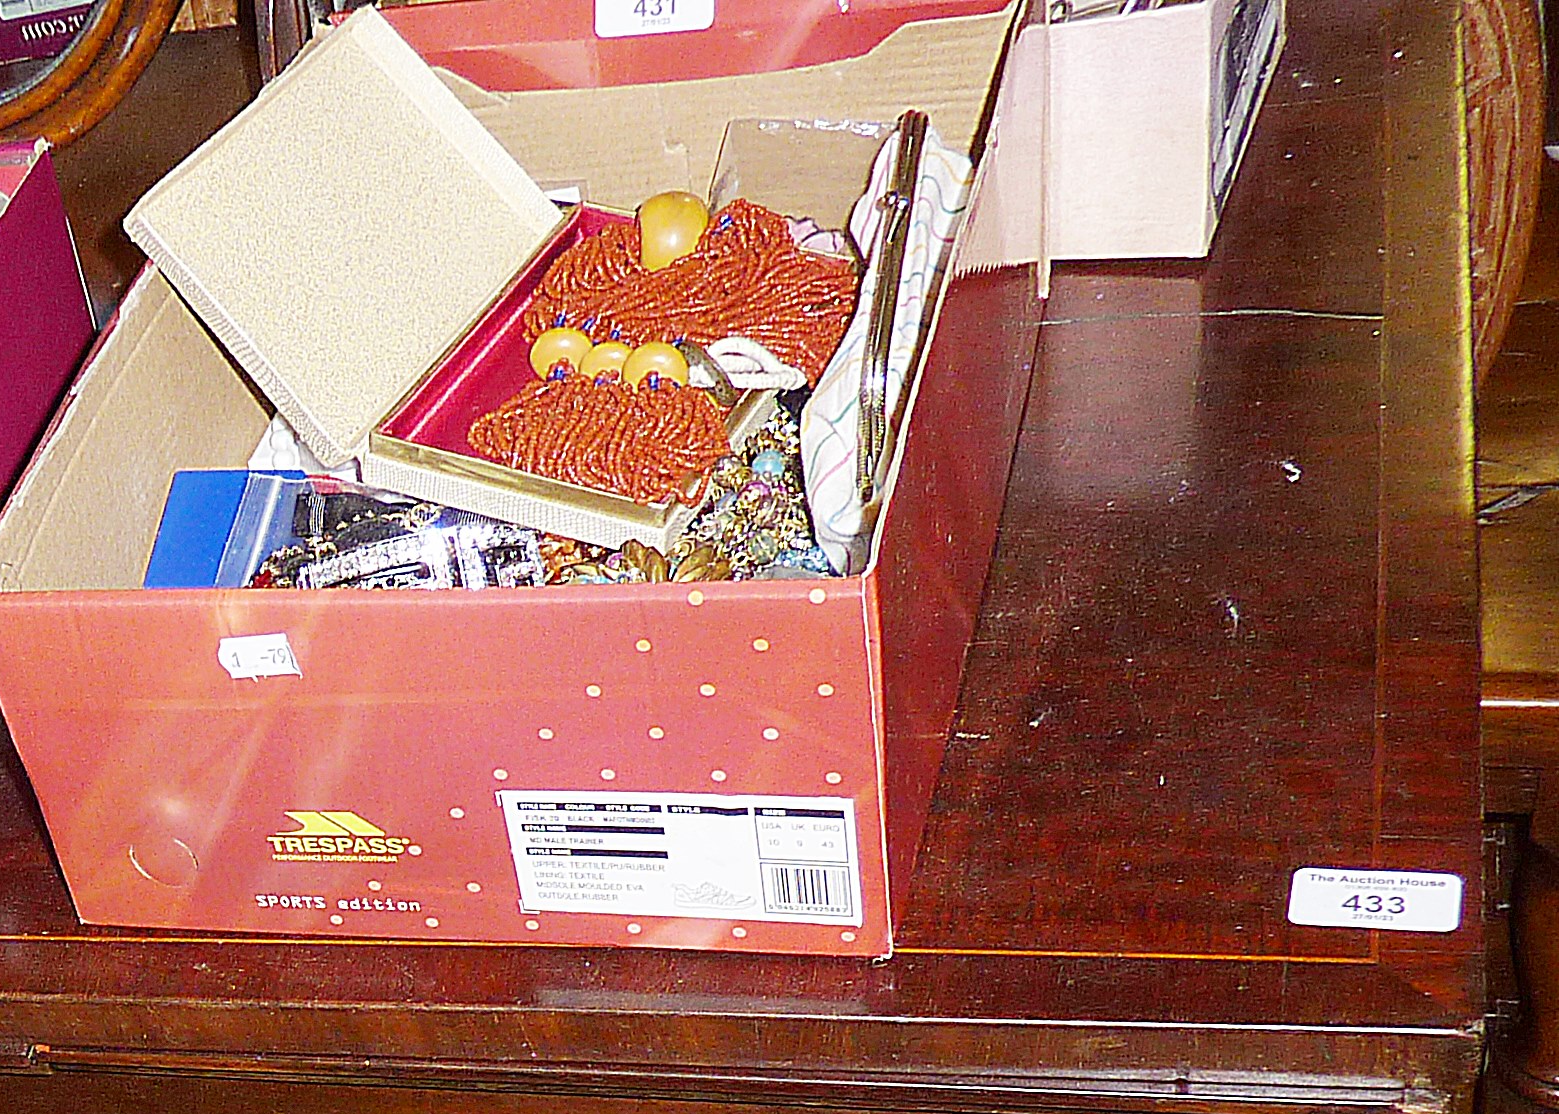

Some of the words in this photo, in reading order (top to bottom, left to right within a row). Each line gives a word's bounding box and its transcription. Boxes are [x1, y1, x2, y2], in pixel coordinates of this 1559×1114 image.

[761, 822, 782, 830] USA
[792, 823, 806, 831] UK
[813, 824, 840, 832] EURO
[266, 837, 406, 854] TRESPASS
[1309, 873, 1335, 882] The
[1340, 875, 1395, 885] Auction
[1399, 878, 1447, 887] House
[255, 894, 327, 909] SPORTS
[337, 897, 421, 912] edition
[1341, 895, 1406, 914] 433
